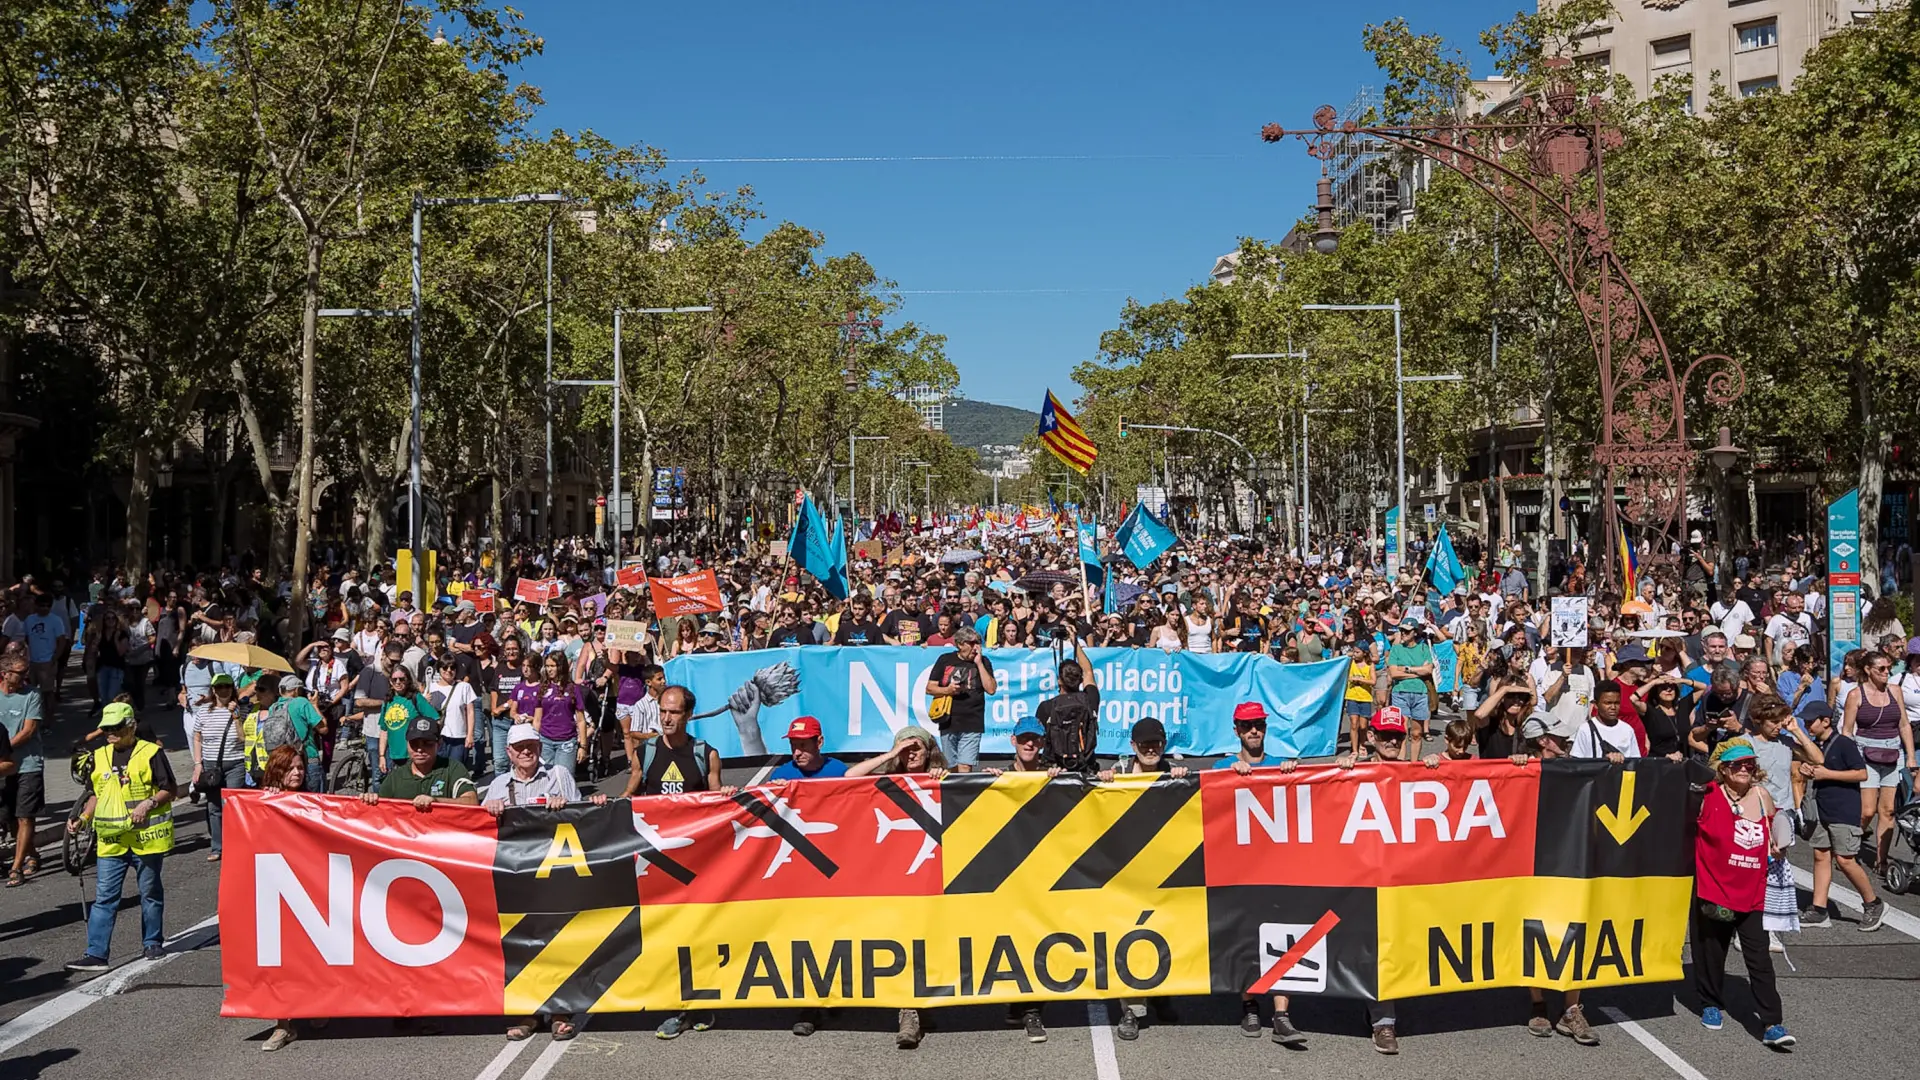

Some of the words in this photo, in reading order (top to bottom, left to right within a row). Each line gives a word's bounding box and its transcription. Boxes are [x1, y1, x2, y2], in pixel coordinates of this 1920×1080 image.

[672, 574, 707, 586] defensa
[993, 669, 1009, 692] a
[992, 694, 1028, 724] de
[661, 782, 684, 795] SOS
[1236, 785, 1313, 845] NI
[1341, 780, 1506, 844] ARA
[535, 823, 592, 879] A
[256, 853, 468, 967] NO
[678, 910, 1171, 1001] L'AMPLIACIÓ
[1429, 923, 1495, 987] NI
[1523, 919, 1644, 980] MAI
